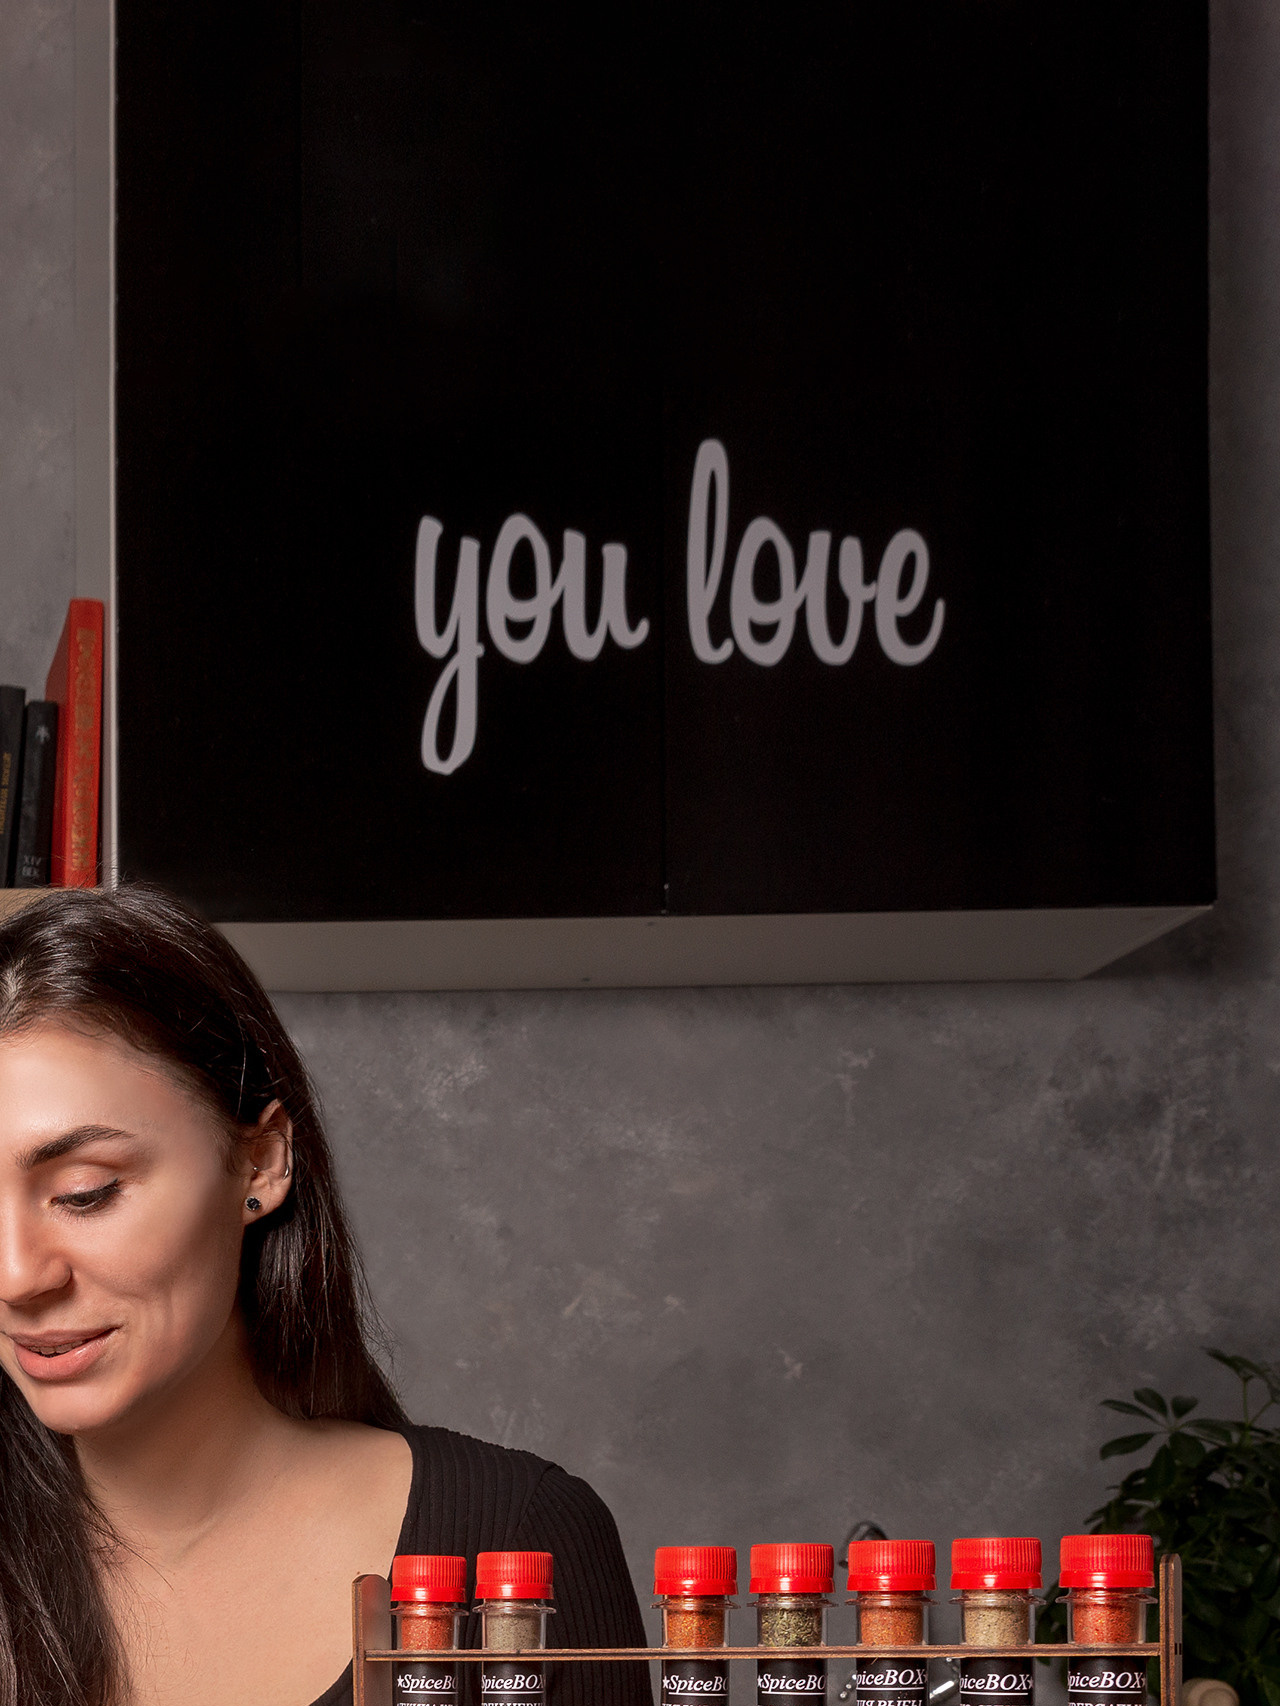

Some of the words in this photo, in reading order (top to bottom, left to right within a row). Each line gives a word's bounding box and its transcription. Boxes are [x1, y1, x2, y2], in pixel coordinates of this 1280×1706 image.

[415, 512, 649, 775] you
[687, 437, 945, 667] love
[959, 1673, 1029, 1692] piceBOX
